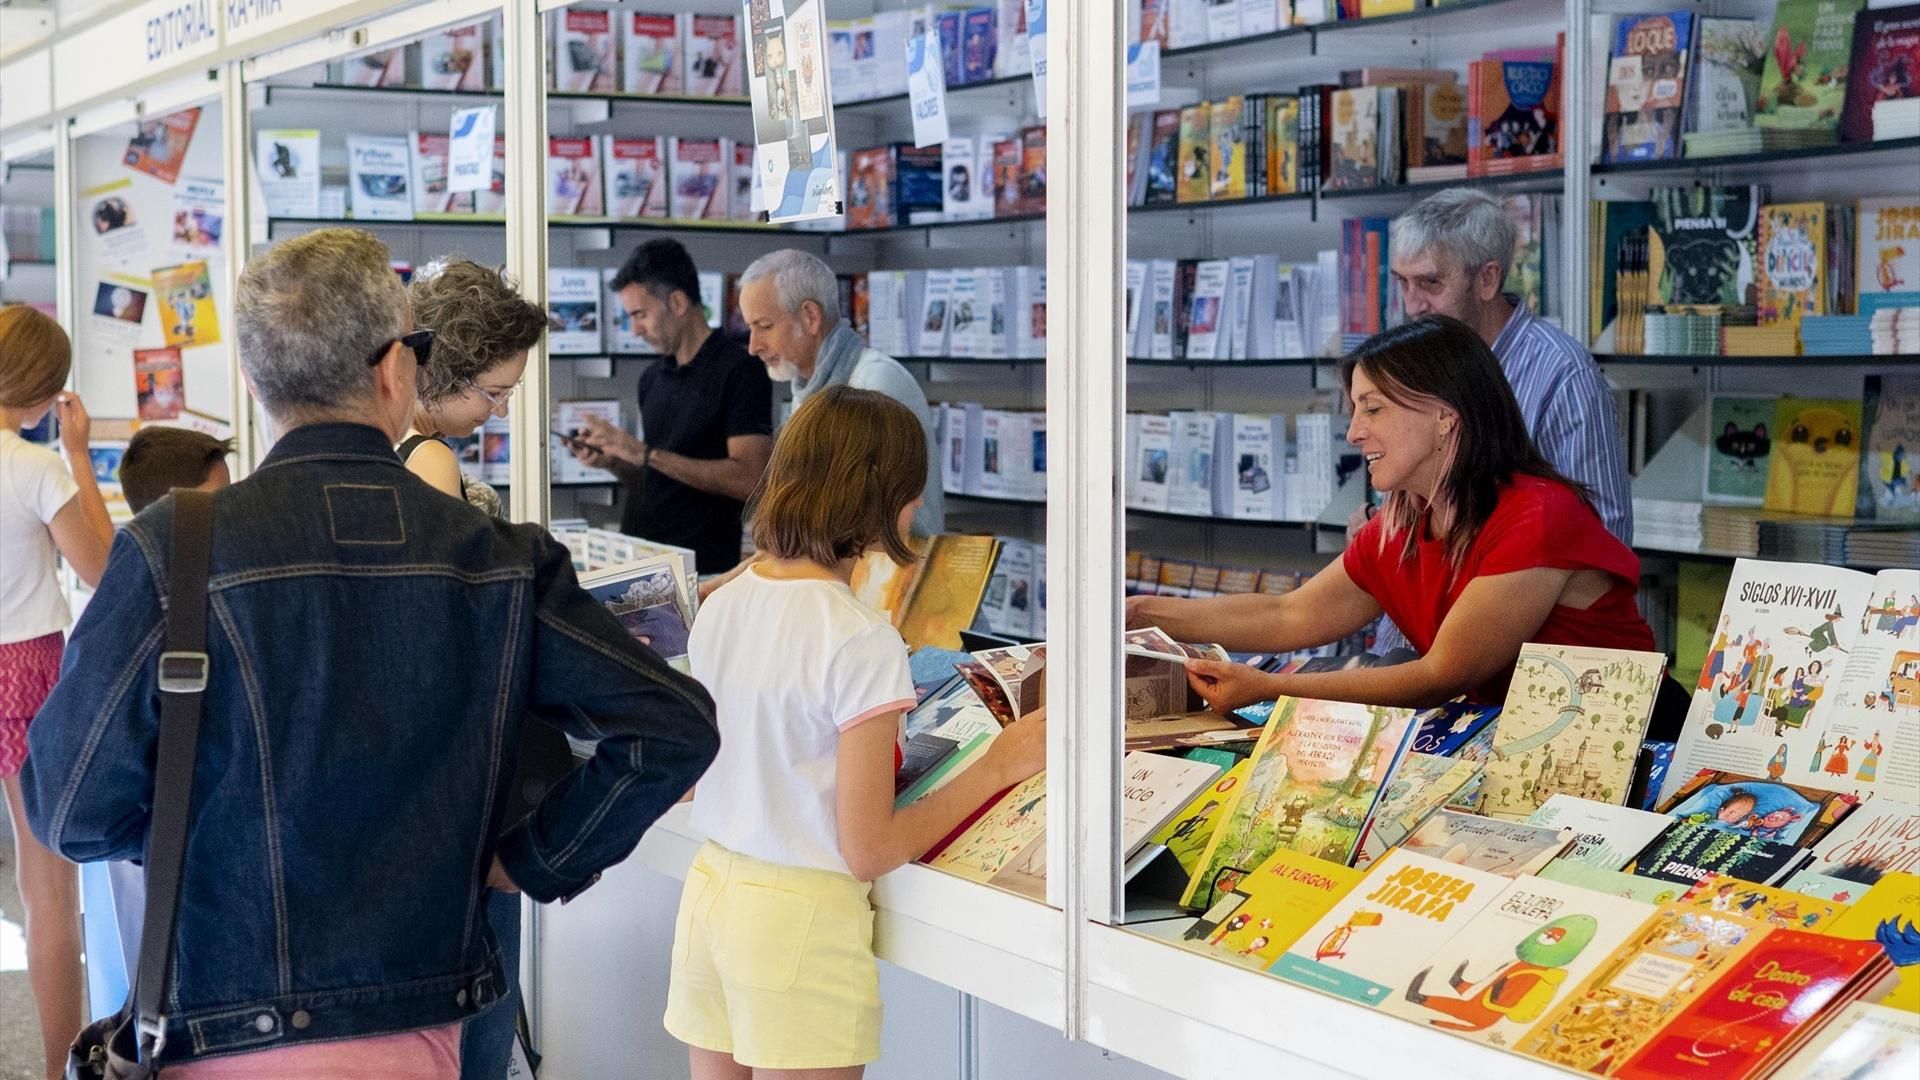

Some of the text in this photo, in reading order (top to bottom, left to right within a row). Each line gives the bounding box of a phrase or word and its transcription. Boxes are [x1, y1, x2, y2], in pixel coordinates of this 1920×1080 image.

[147, 0, 215, 60] EDITORIAL
[1674, 218, 1714, 230] PIENSA
[1740, 581, 1837, 610] SIGLOS XVI-XVII
[1132, 768, 1154, 781] UN
[1287, 868, 1339, 892] FURGÓN!
[1662, 861, 1712, 881] PIENS
[1385, 864, 1476, 903] JOSEFA
[1366, 883, 1456, 923] JIRAFA
[1500, 901, 1553, 921] CHULETA
[1508, 890, 1564, 911] EL ZORRO
[1755, 960, 1811, 985] Dentro
[1728, 983, 1788, 1010] de casa
